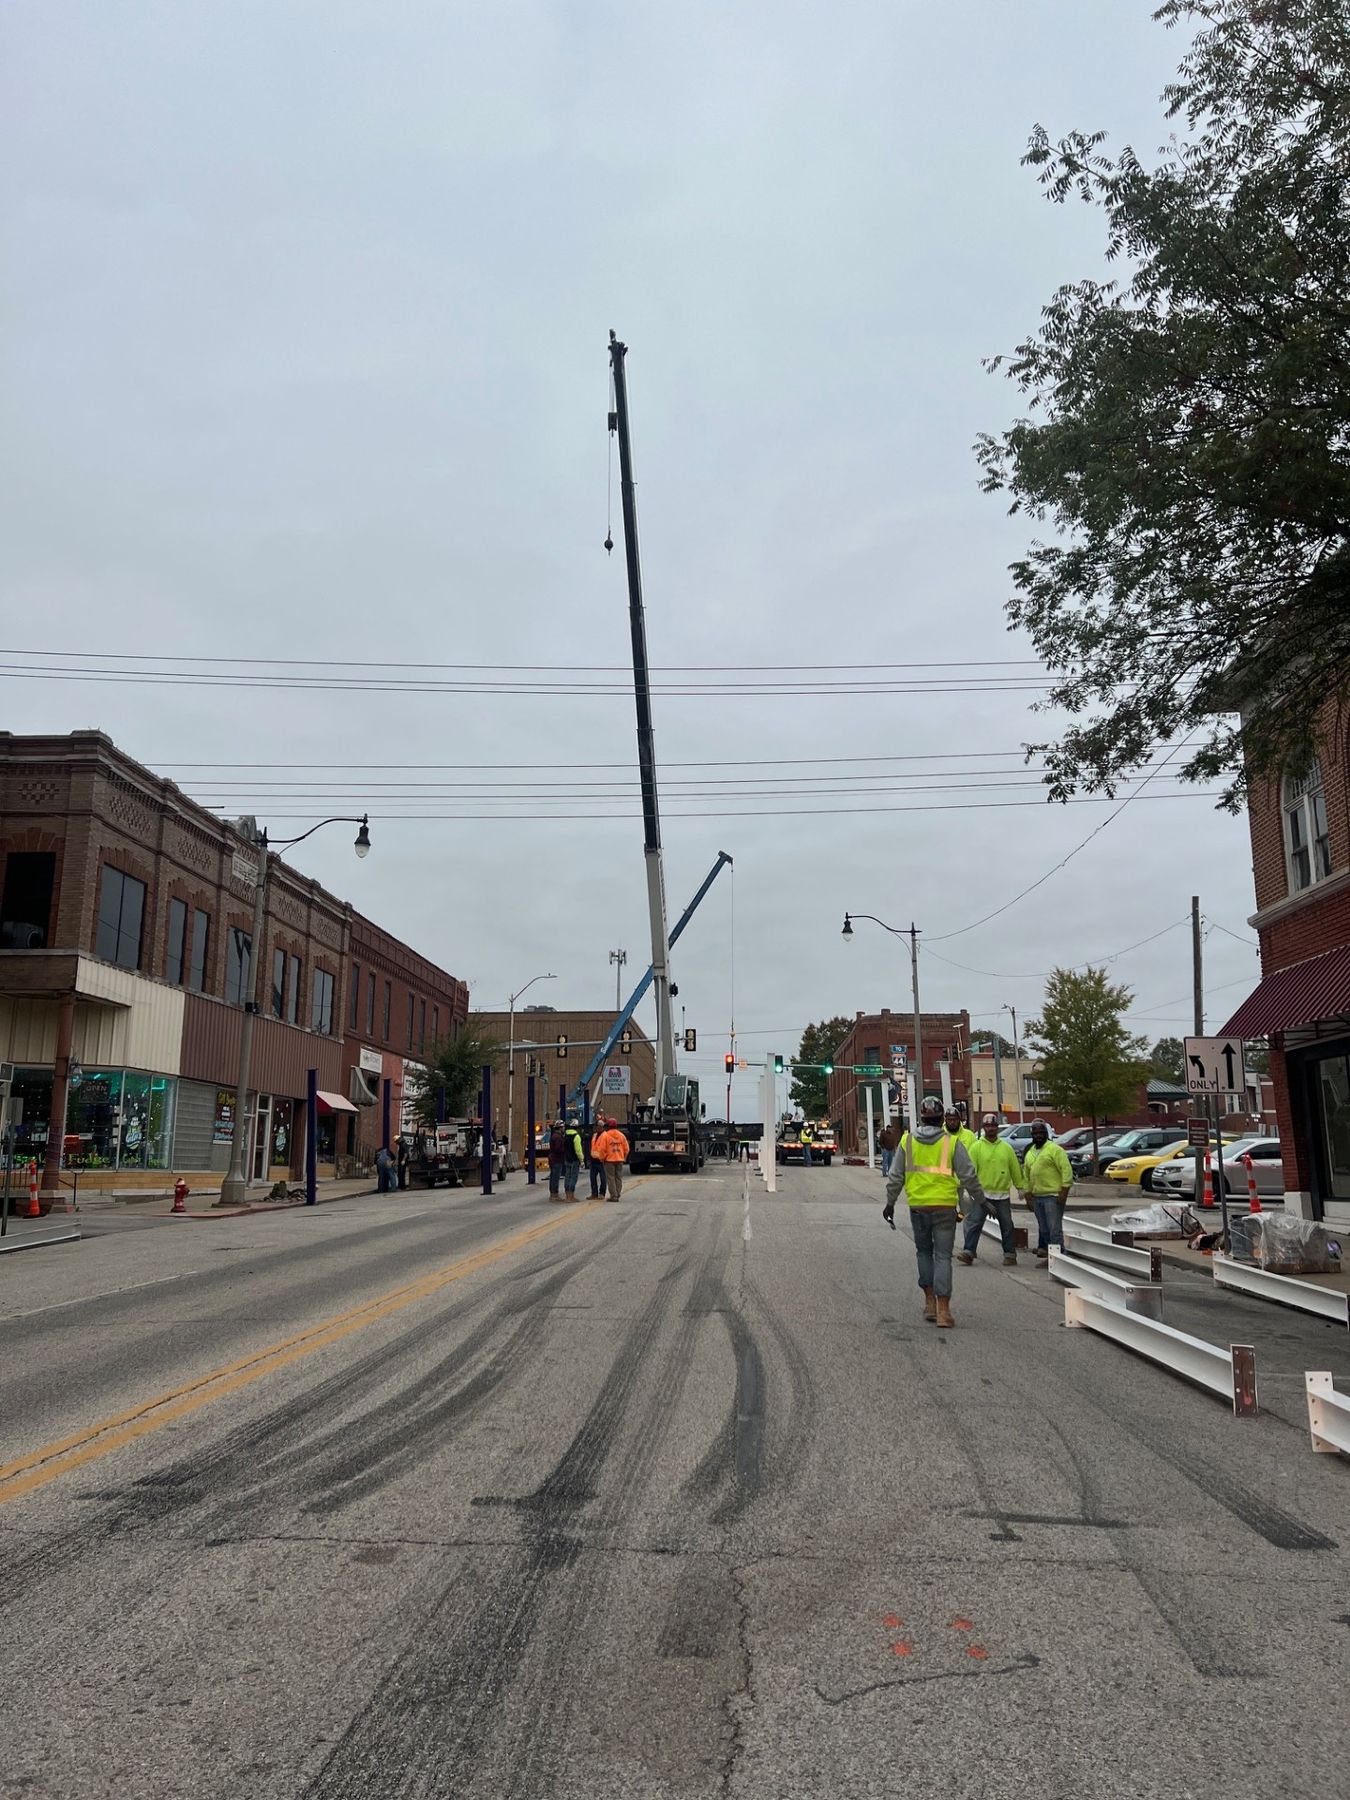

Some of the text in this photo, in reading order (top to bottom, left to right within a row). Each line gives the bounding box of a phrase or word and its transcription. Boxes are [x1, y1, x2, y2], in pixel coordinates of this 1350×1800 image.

[894, 1057, 904, 1065] 44
[1190, 1080, 1216, 1089] ONLY
[68, 1152, 110, 1165] Fudge
